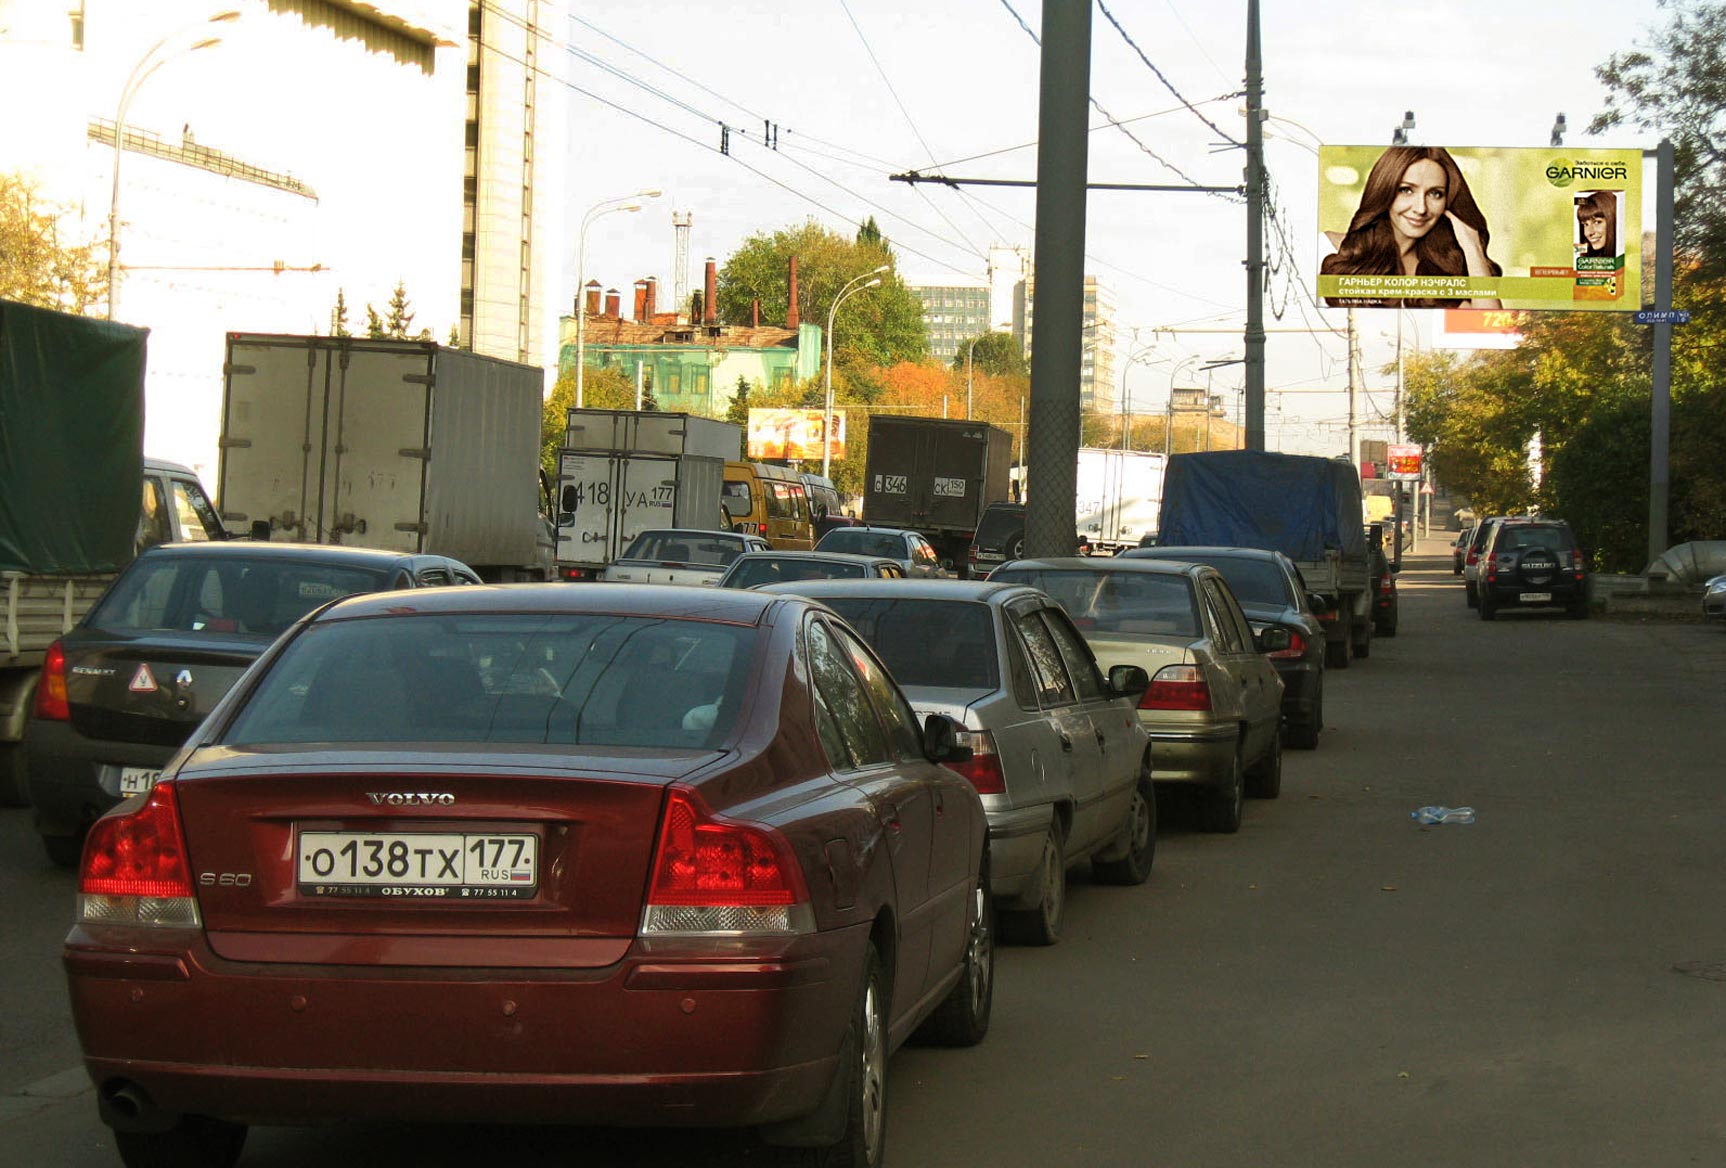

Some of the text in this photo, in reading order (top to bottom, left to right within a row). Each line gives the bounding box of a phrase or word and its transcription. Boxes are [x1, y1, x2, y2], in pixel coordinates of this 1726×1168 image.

[1546, 166, 1627, 179] GARNIER
[1338, 277, 1467, 287] ГАРНЬЕР КОЛОР НЭЧРАЛС
[1338, 287, 1376, 295] стойкая
[1378, 289, 1437, 297] крем-краска
[1447, 288, 1454, 296] 3
[1455, 289, 1497, 297] маслами
[885, 476, 906, 492] 346
[651, 486, 673, 500] 177
[365, 792, 456, 806] VOLVO
[469, 838, 526, 869] 177
[481, 869, 509, 881] RUS
